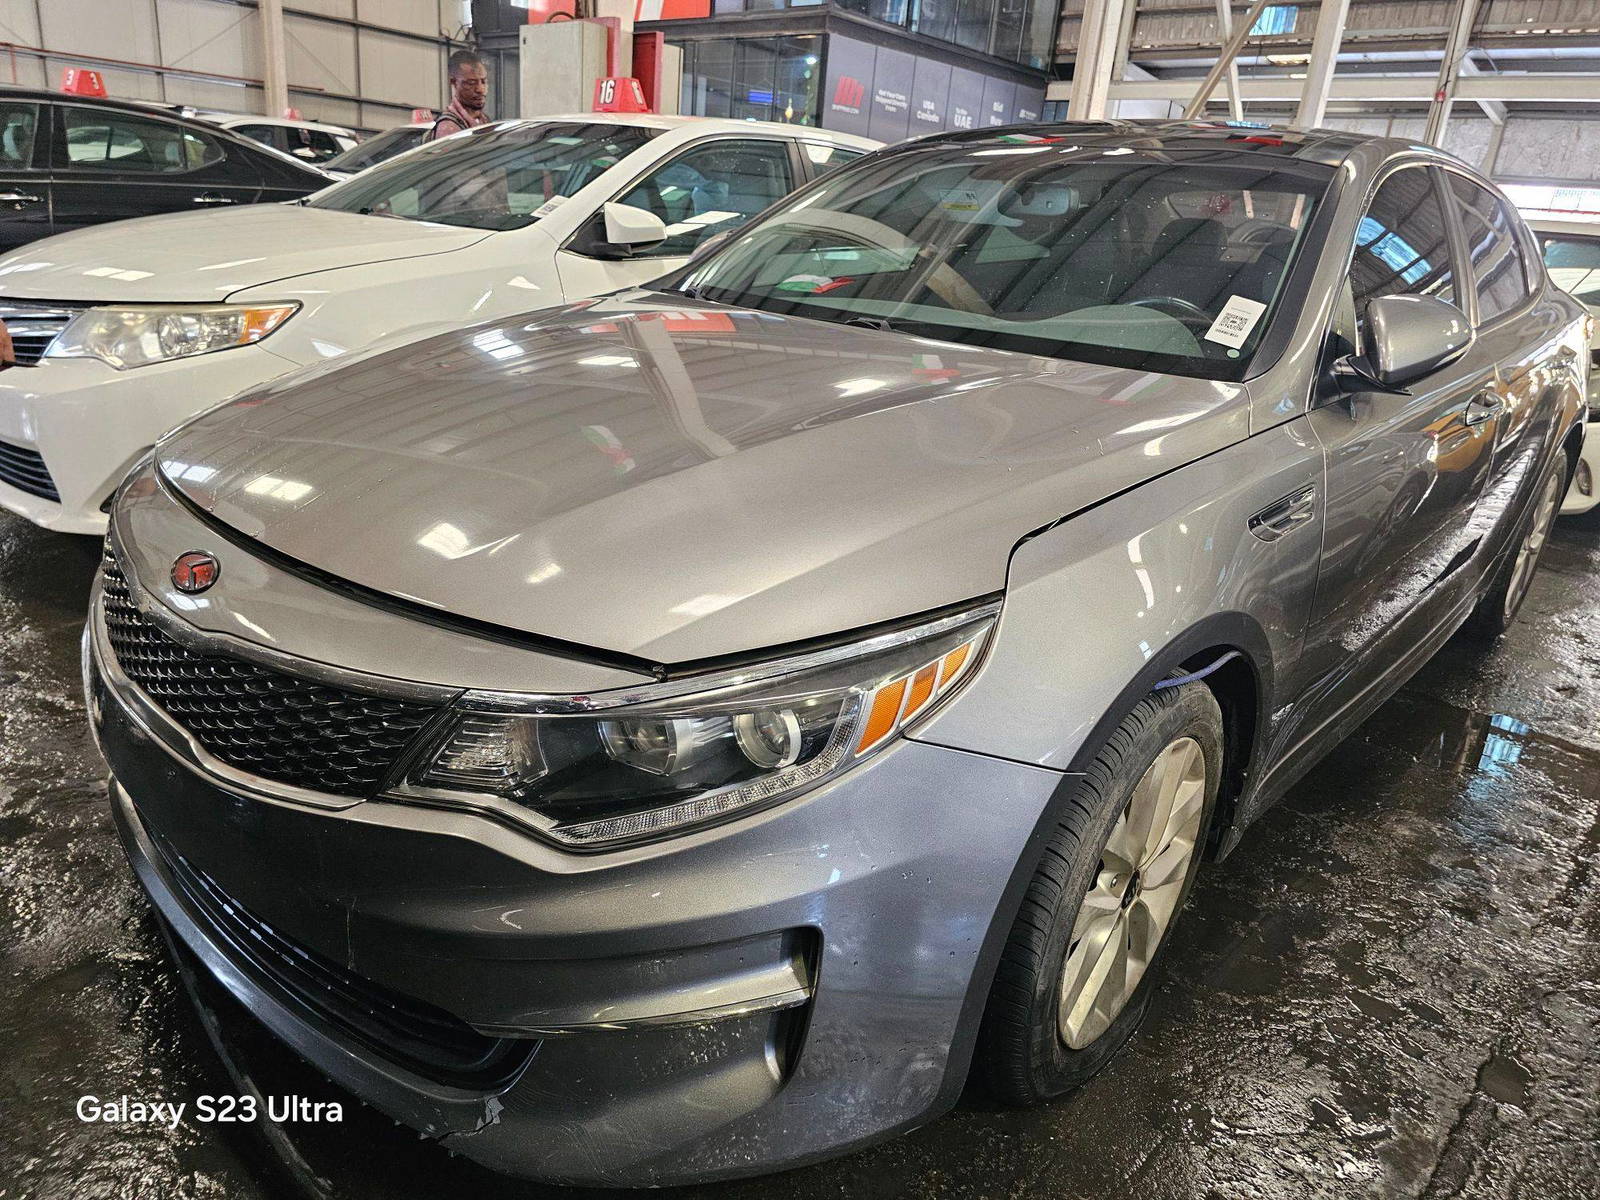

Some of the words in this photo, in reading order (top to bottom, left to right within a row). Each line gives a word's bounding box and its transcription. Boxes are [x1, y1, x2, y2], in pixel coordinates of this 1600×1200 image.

[66, 69, 74, 86] 3
[89, 72, 99, 90] 3
[600, 80, 615, 104] 16
[922, 100, 934, 110] USA
[954, 114, 973, 129] UAE
